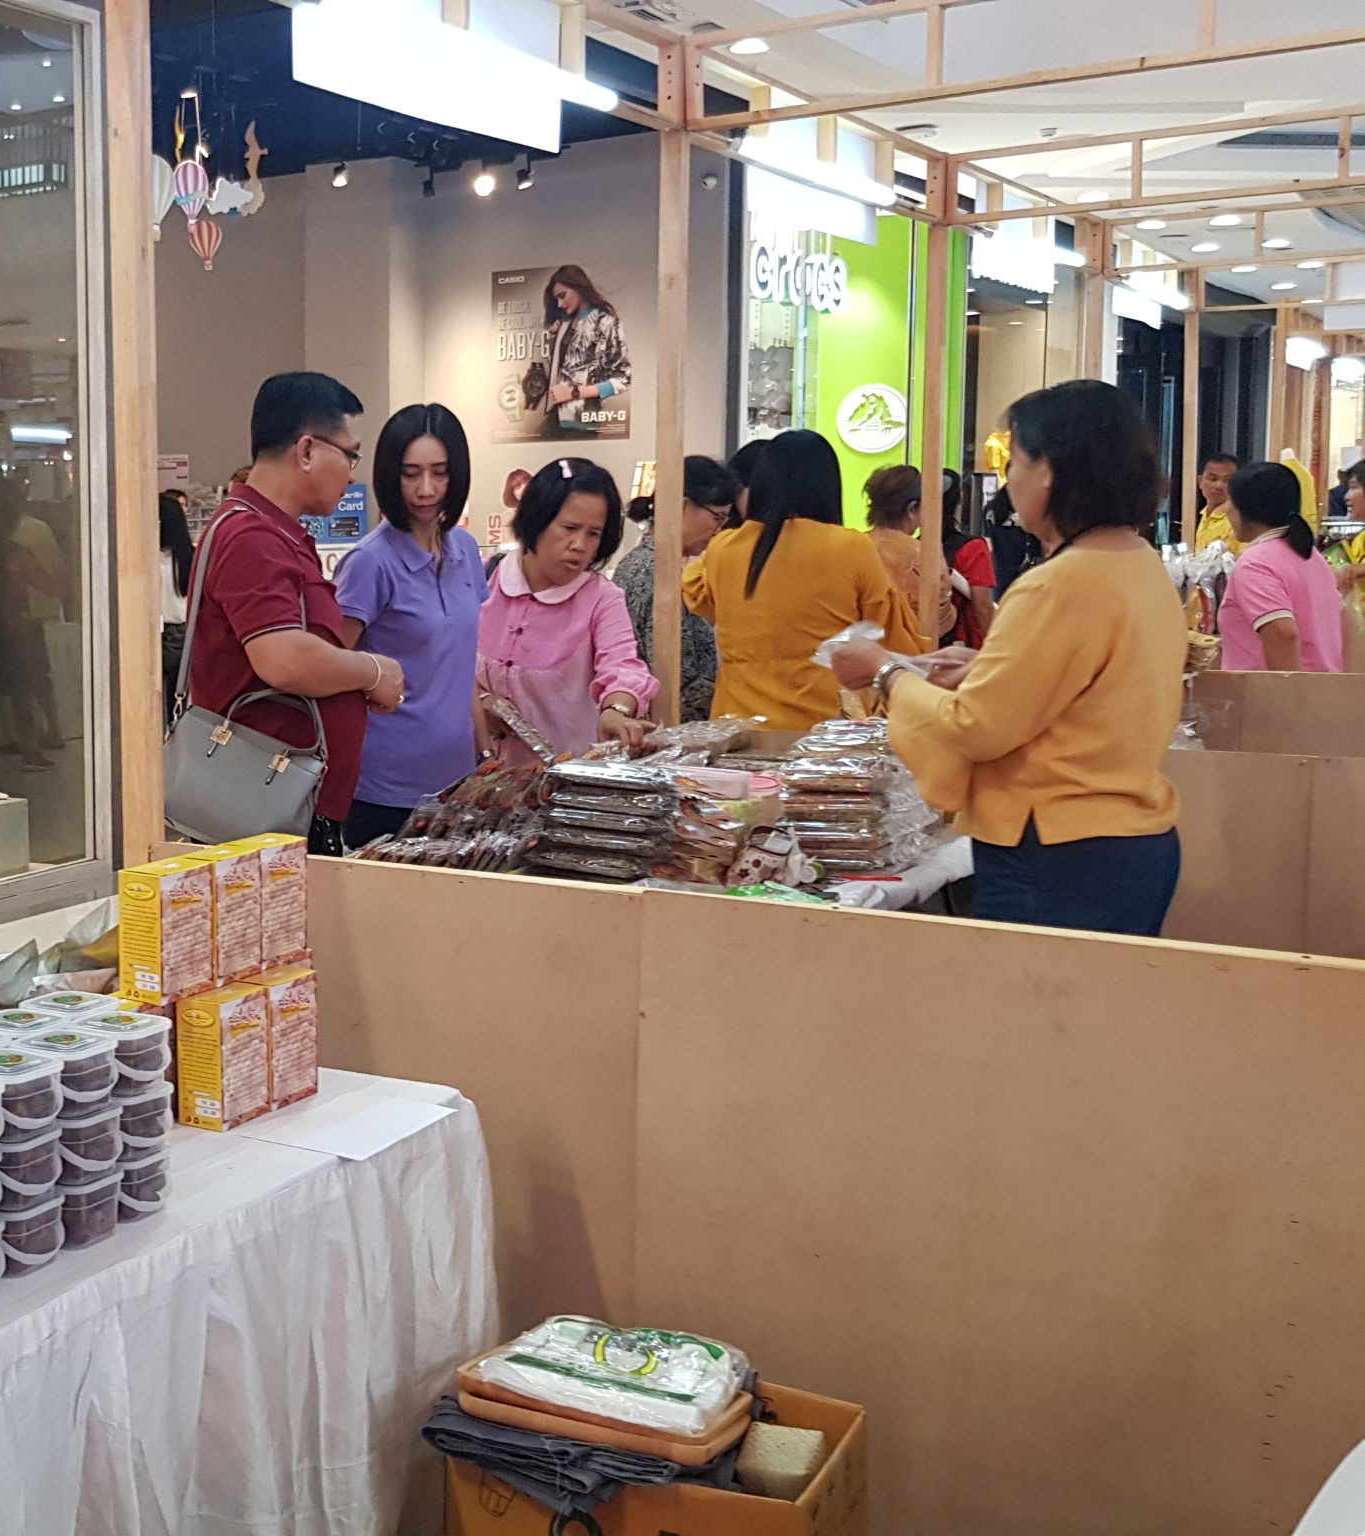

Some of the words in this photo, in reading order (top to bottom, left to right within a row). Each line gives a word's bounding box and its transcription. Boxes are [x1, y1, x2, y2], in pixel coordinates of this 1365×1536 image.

[498, 276, 525, 285] CASIO
[498, 331, 550, 361] BABY-G
[581, 410, 627, 423] BABY-G
[337, 501, 364, 511] Card
